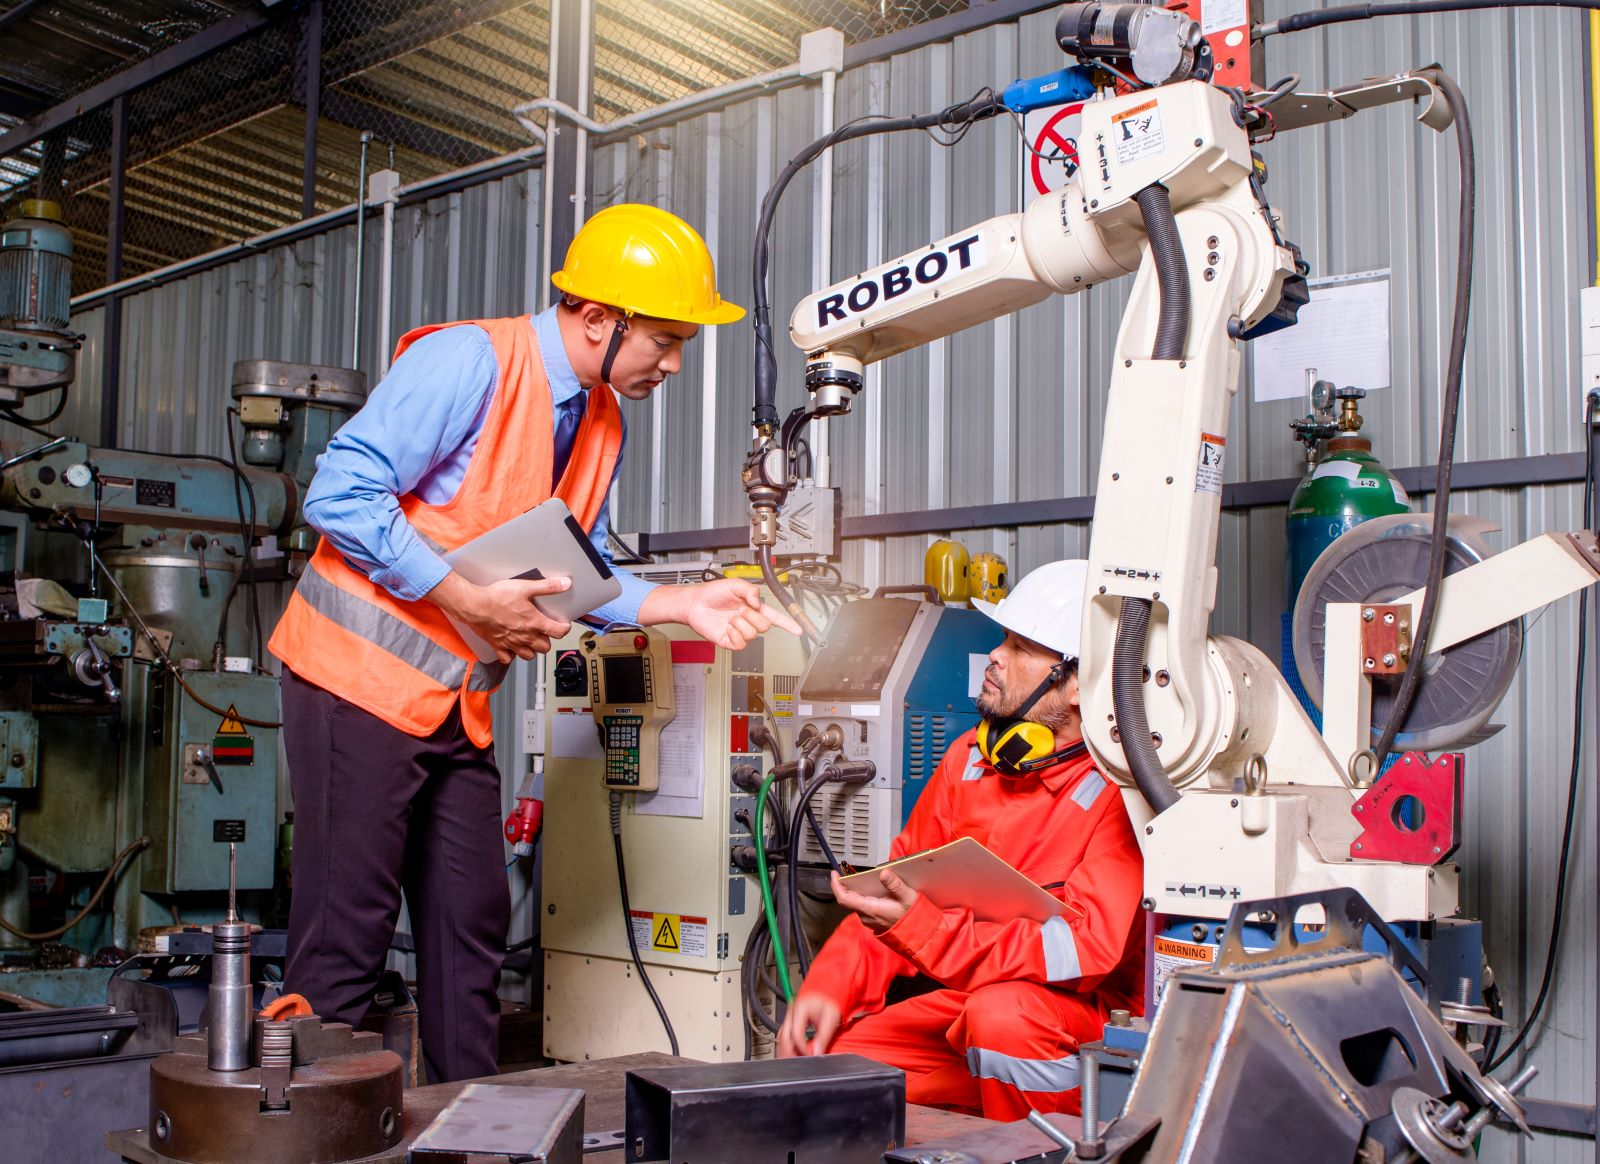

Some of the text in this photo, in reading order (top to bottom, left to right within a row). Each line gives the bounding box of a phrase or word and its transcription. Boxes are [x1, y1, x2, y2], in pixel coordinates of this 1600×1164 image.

[1099, 158, 1108, 167] 3
[817, 234, 979, 328] ROBOT
[1127, 569, 1136, 579] 2
[1197, 885, 1206, 898] 1
[1164, 943, 1206, 959] WARNING
